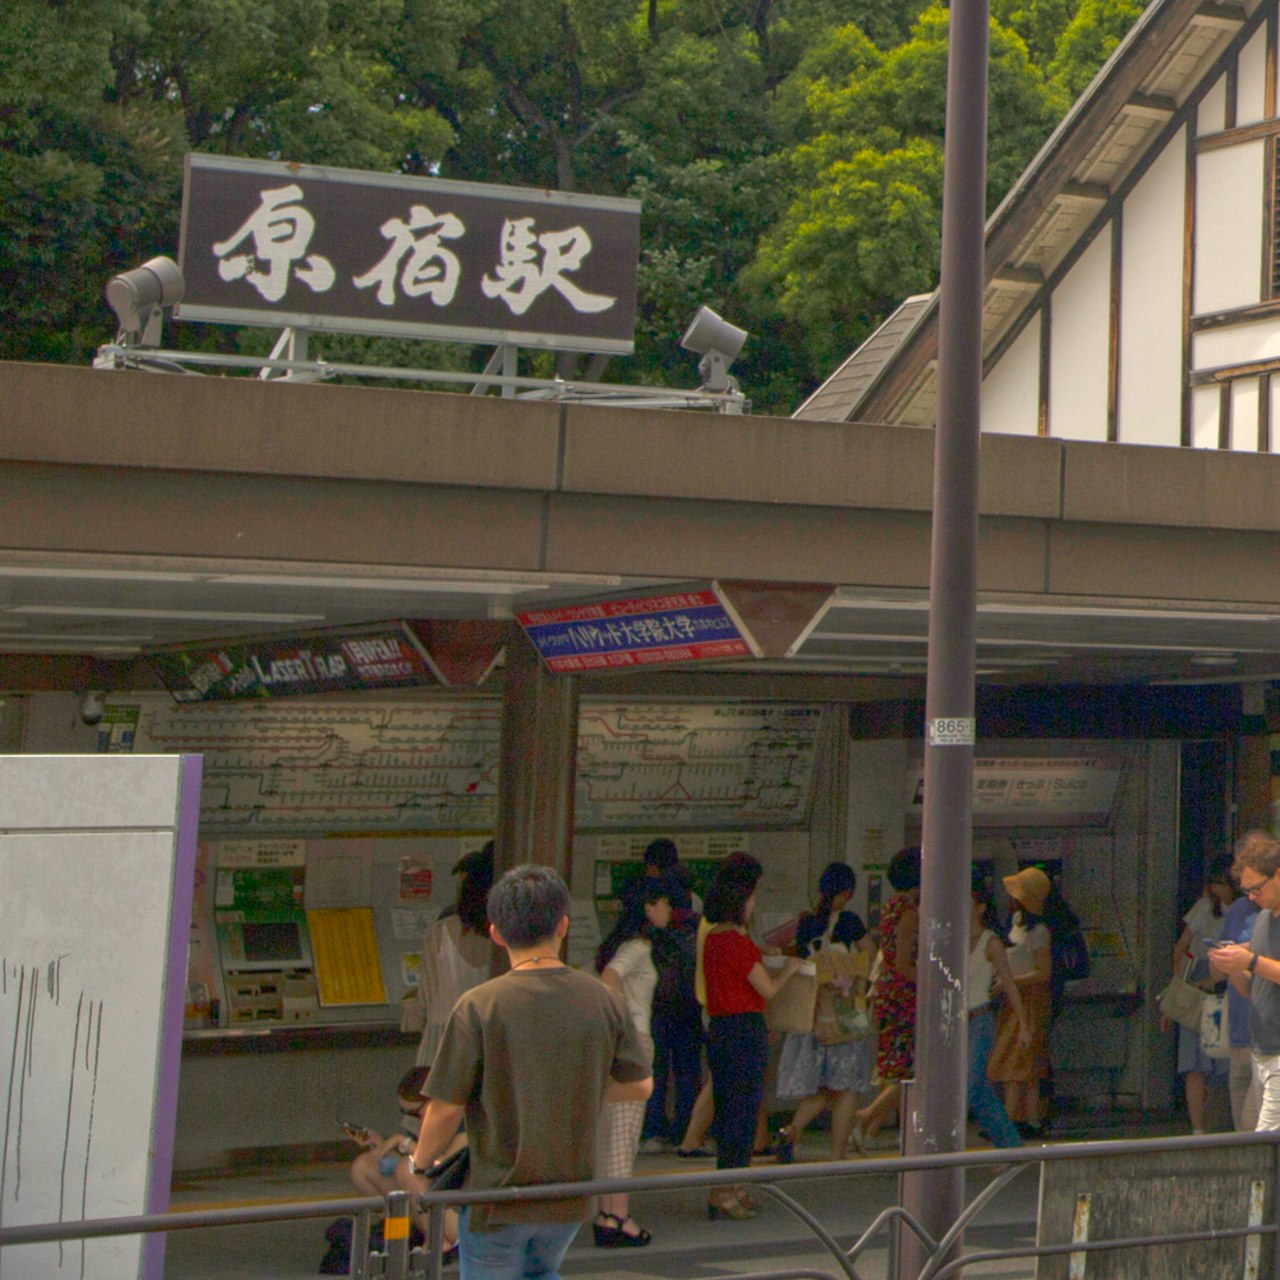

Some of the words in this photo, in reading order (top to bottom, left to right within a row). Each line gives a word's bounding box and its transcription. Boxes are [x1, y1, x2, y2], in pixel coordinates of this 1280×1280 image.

[213, 184, 617, 315] 原宿駅
[1053, 778, 1088, 790] Suica
